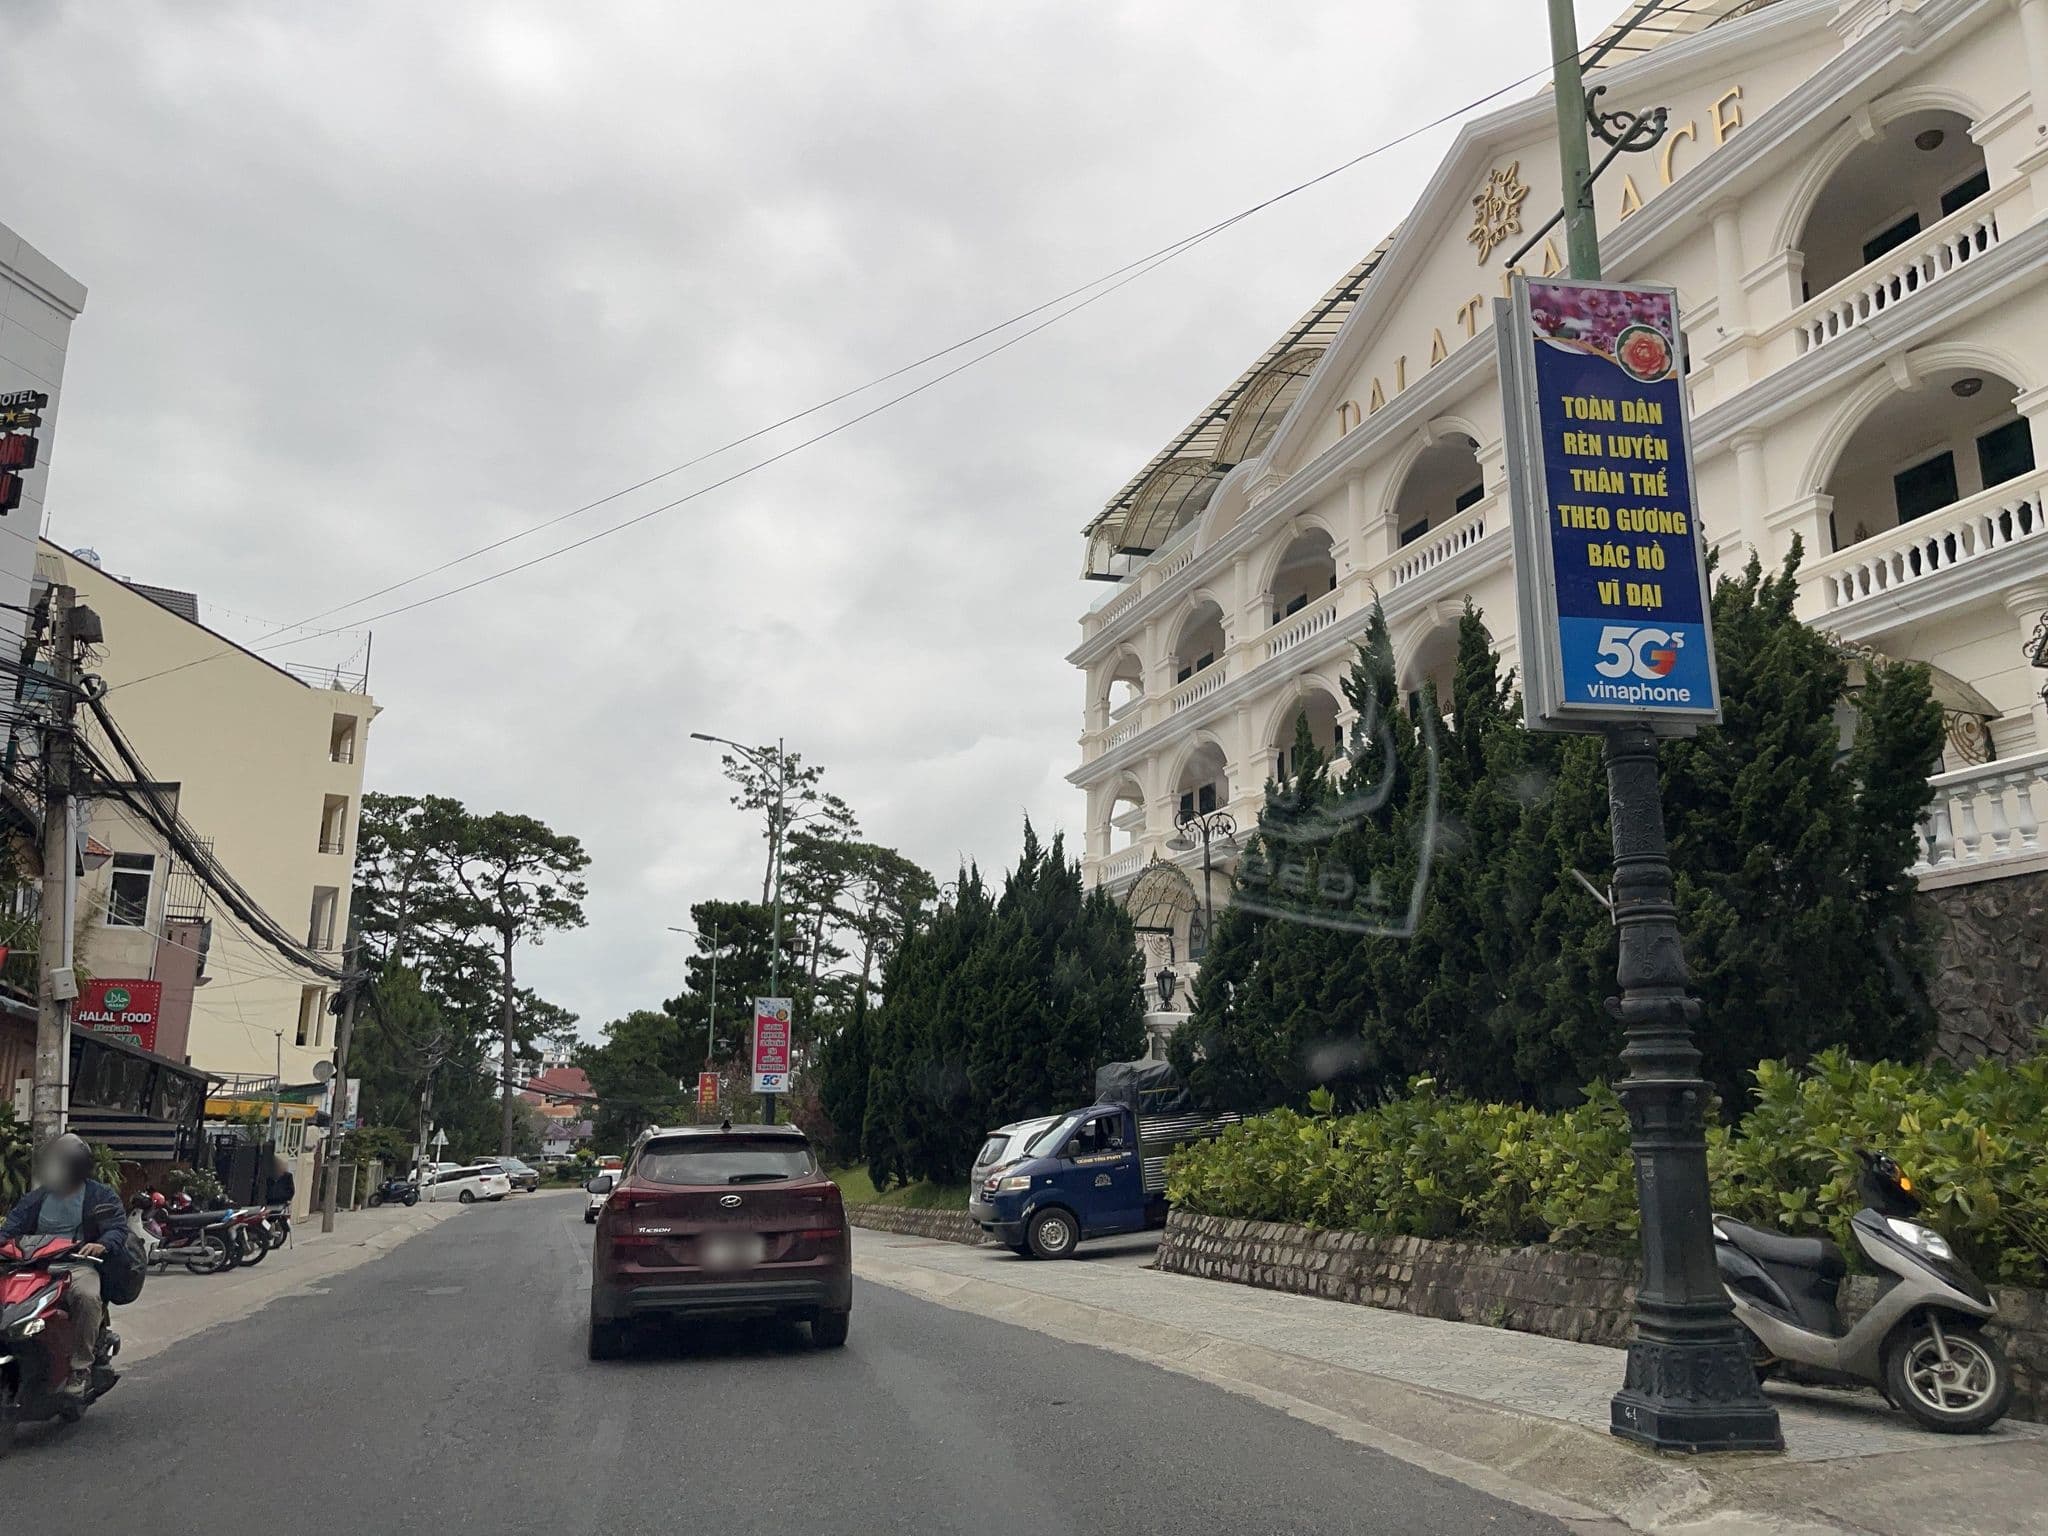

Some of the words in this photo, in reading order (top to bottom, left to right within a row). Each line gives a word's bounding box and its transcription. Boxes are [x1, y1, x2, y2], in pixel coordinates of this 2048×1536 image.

[0, 390, 36, 406] OTEL
[1561, 395, 1616, 422] TOÀN
[1621, 398, 1663, 425] DÂN
[1563, 430, 1603, 457] RÈN
[1607, 434, 1669, 464] LUYỆN
[1569, 466, 1625, 495] THÂN
[1629, 466, 1669, 497] THỂ
[1557, 504, 1610, 531] THEO
[1616, 506, 1687, 535] GƯƠNG
[1587, 541, 1631, 569] BÁC
[1636, 540, 1666, 571] HỒ
[1597, 579, 1621, 606] VĨ
[1626, 582, 1663, 612] ĐẠI
[1587, 680, 1691, 703] vinaphone
[79, 1011, 116, 1022] HALAL
[121, 1012, 152, 1023] FOOD
